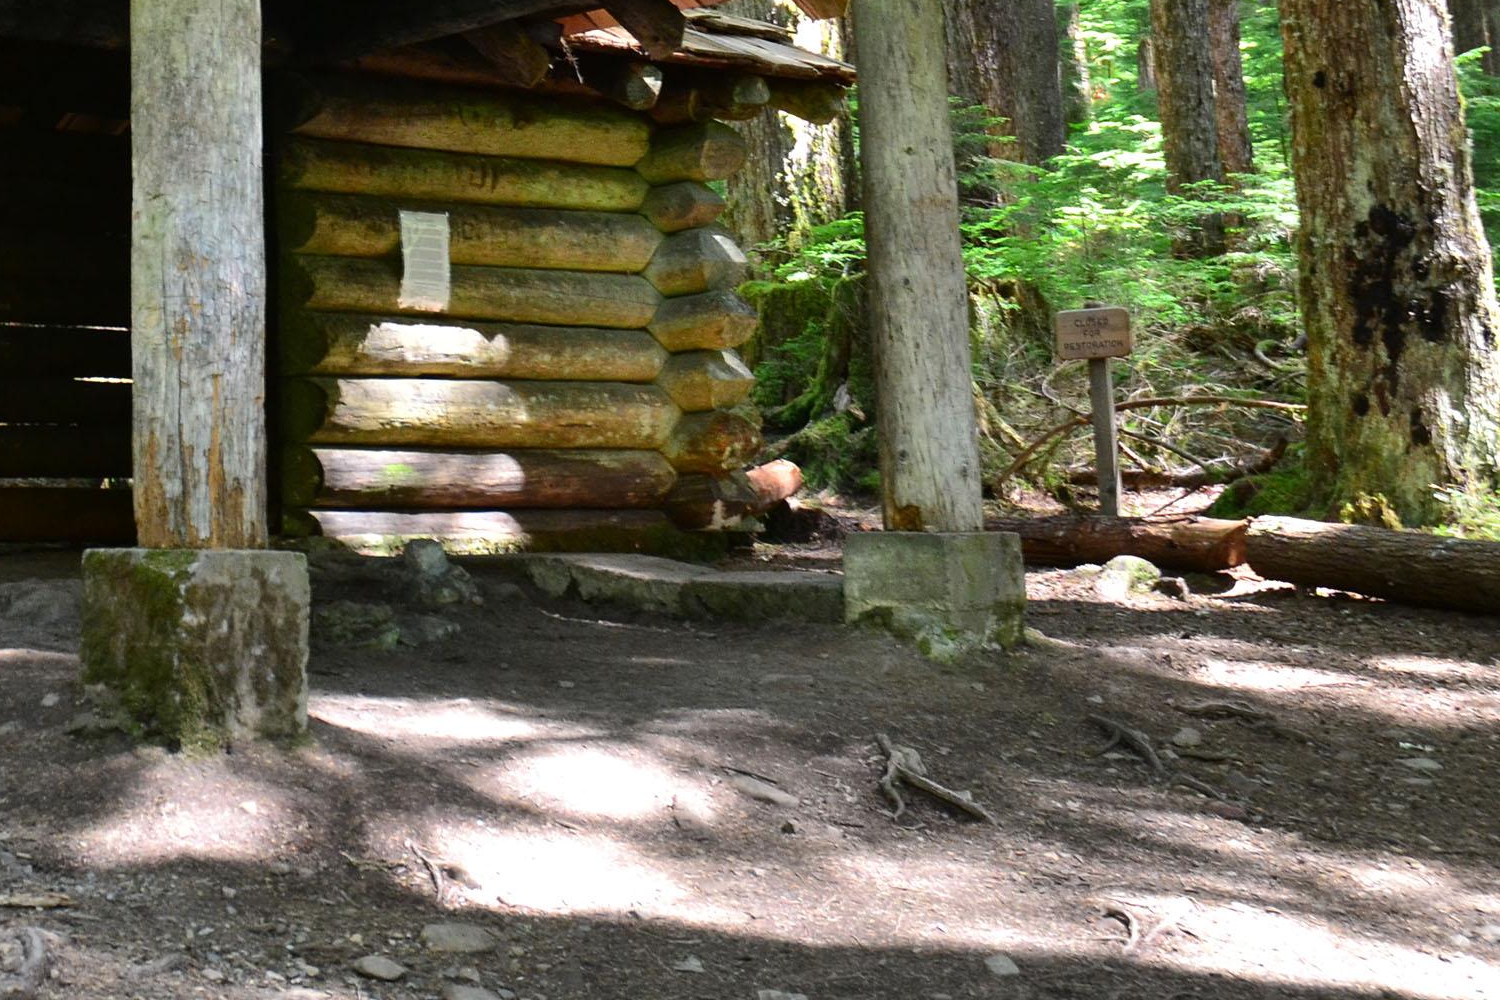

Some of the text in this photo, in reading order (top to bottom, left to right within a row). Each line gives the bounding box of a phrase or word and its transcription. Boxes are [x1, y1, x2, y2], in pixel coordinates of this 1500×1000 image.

[1074, 317, 1109, 328] CLOSED
[1083, 329, 1100, 338] FOR
[1064, 339, 1123, 350] RESTORATION
